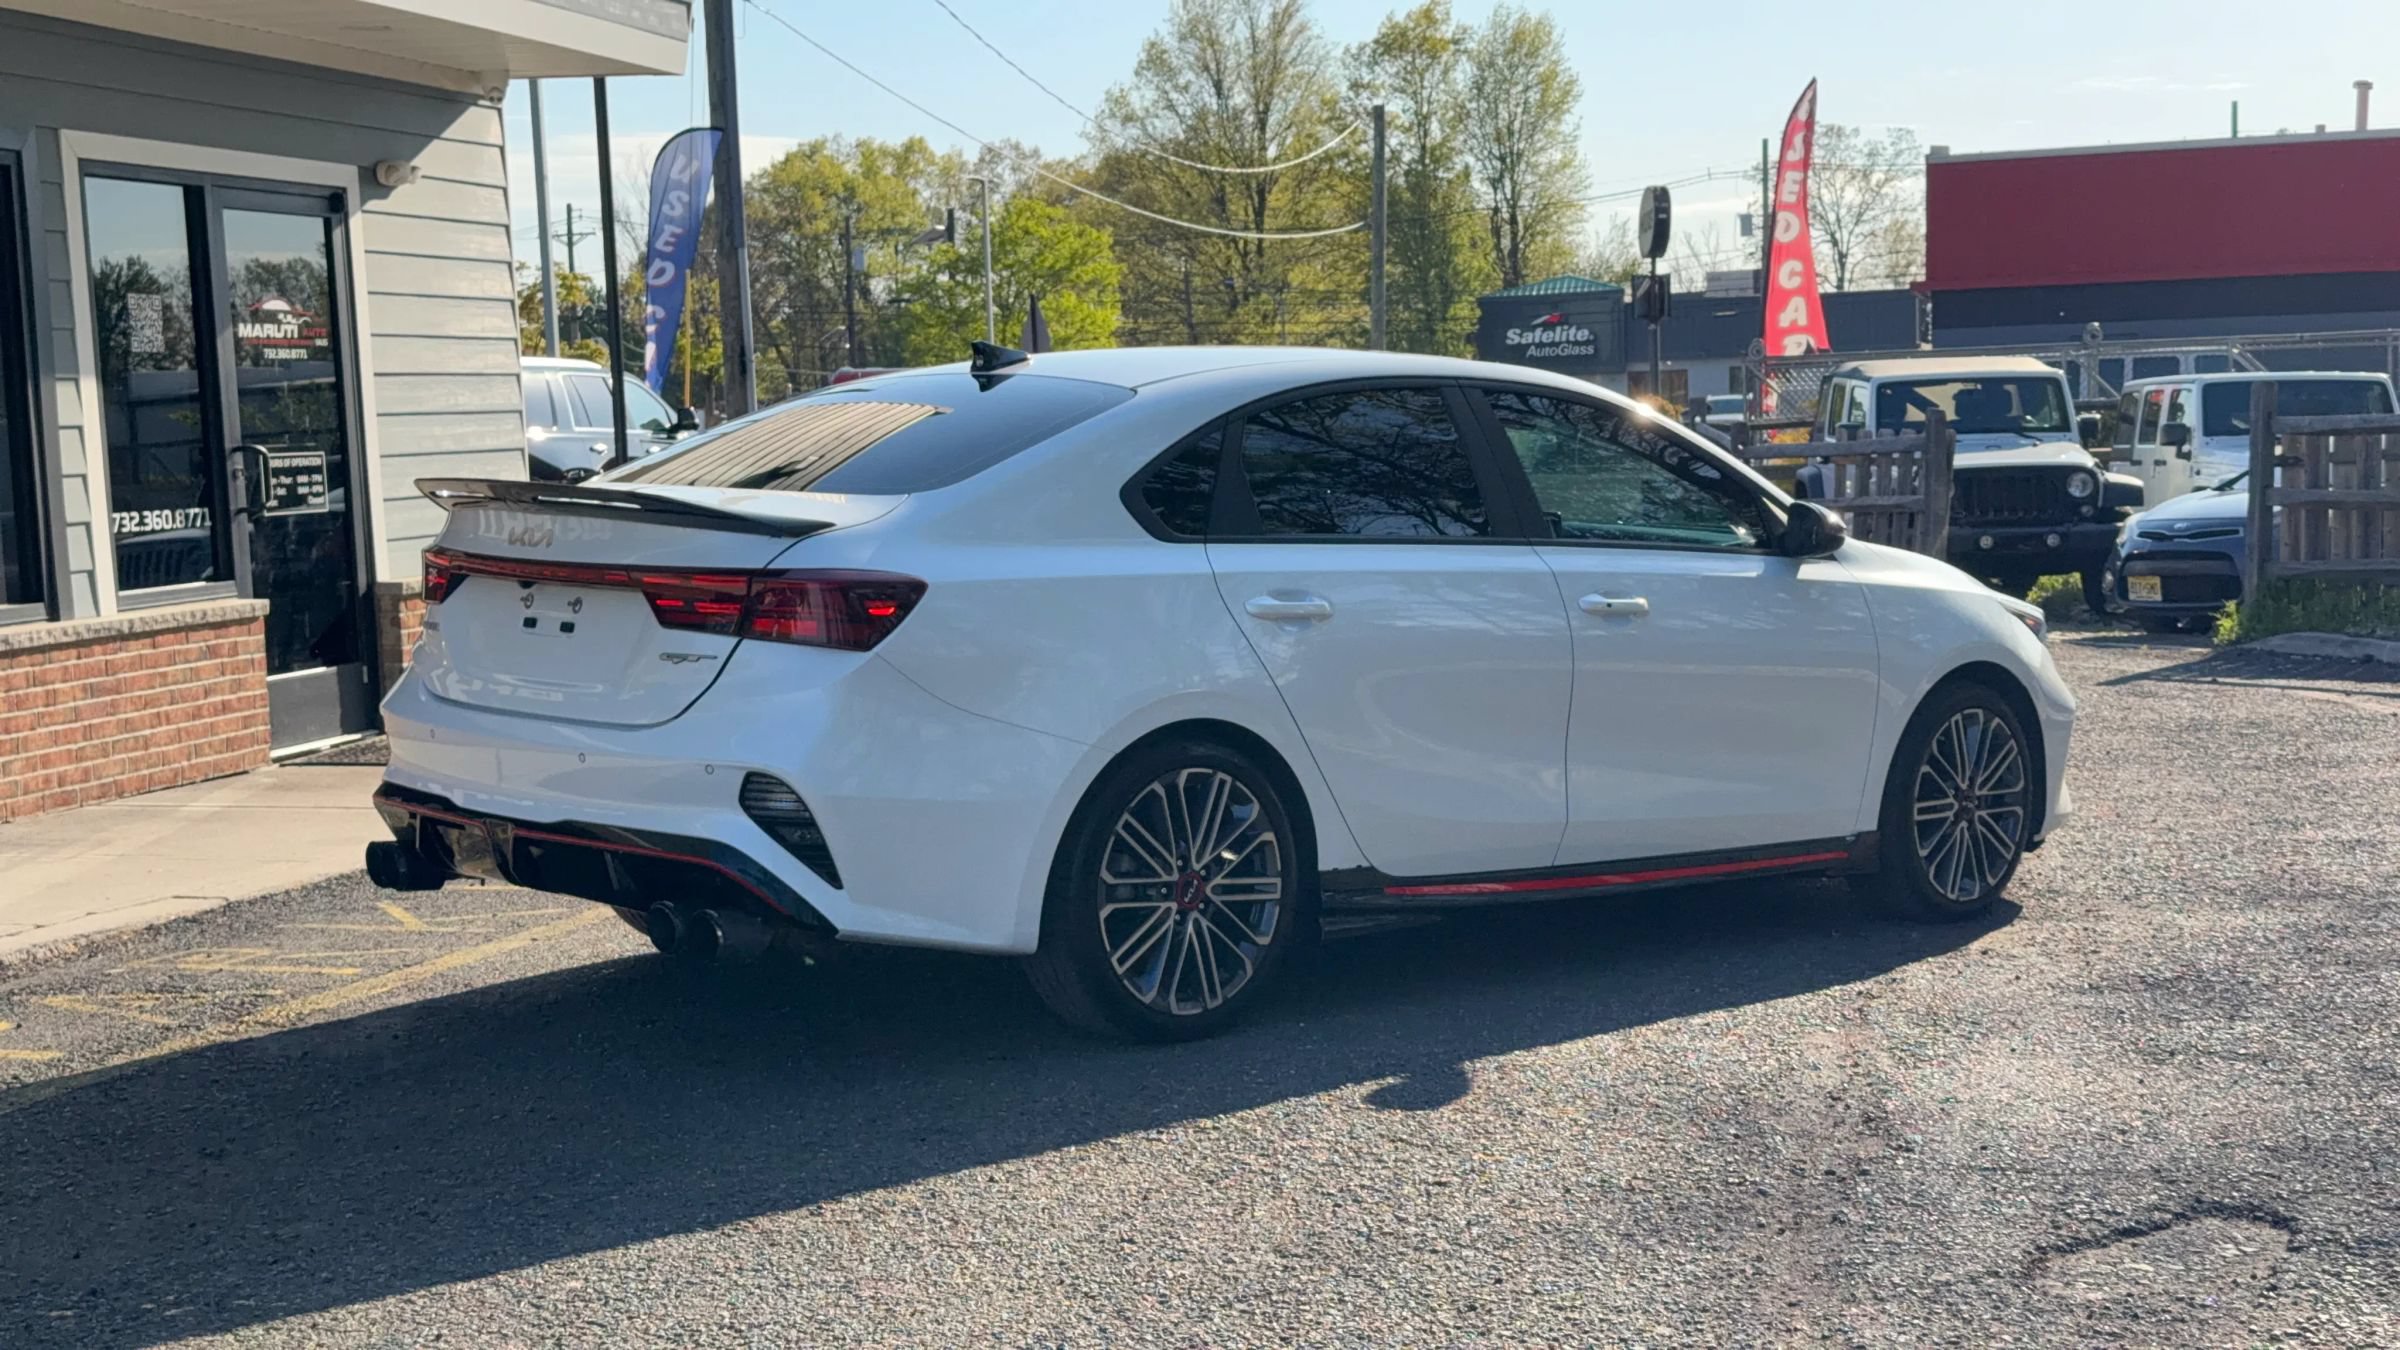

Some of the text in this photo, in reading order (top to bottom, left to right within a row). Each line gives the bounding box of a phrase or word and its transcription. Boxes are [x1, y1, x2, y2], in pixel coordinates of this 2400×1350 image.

[647, 153, 699, 287] USED
[238, 323, 298, 338] MARUTI
[1526, 344, 1595, 358] AutoGlass
[112, 507, 212, 534] 732.360.8771
